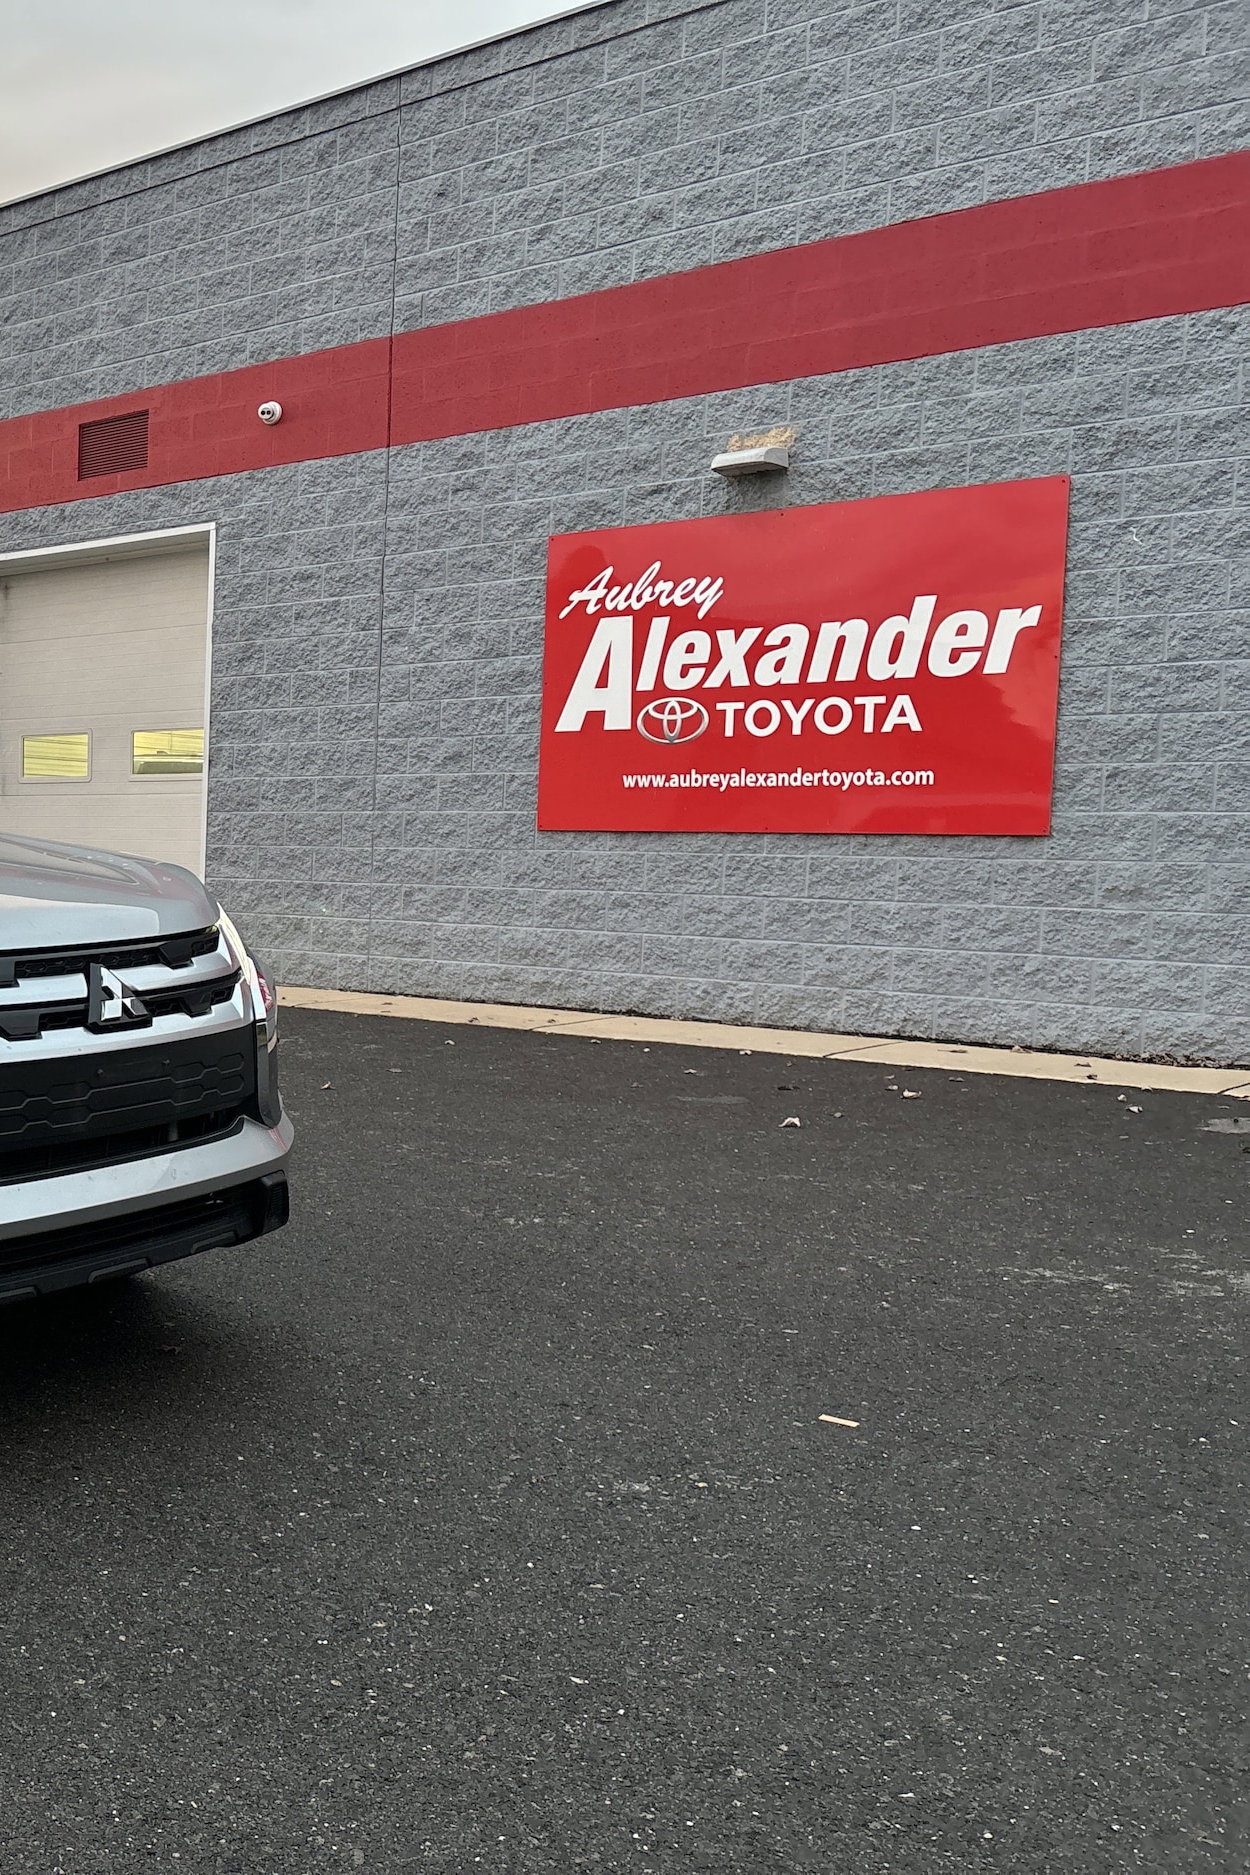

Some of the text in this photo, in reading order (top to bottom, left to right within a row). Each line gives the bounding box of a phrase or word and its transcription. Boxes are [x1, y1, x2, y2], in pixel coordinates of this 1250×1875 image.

[558, 560, 724, 620] Aubrey
[554, 594, 1043, 733] Alexander
[715, 694, 923, 738] TOYOTA
[622, 767, 935, 792] www.aubreyalexandertoyota.com
